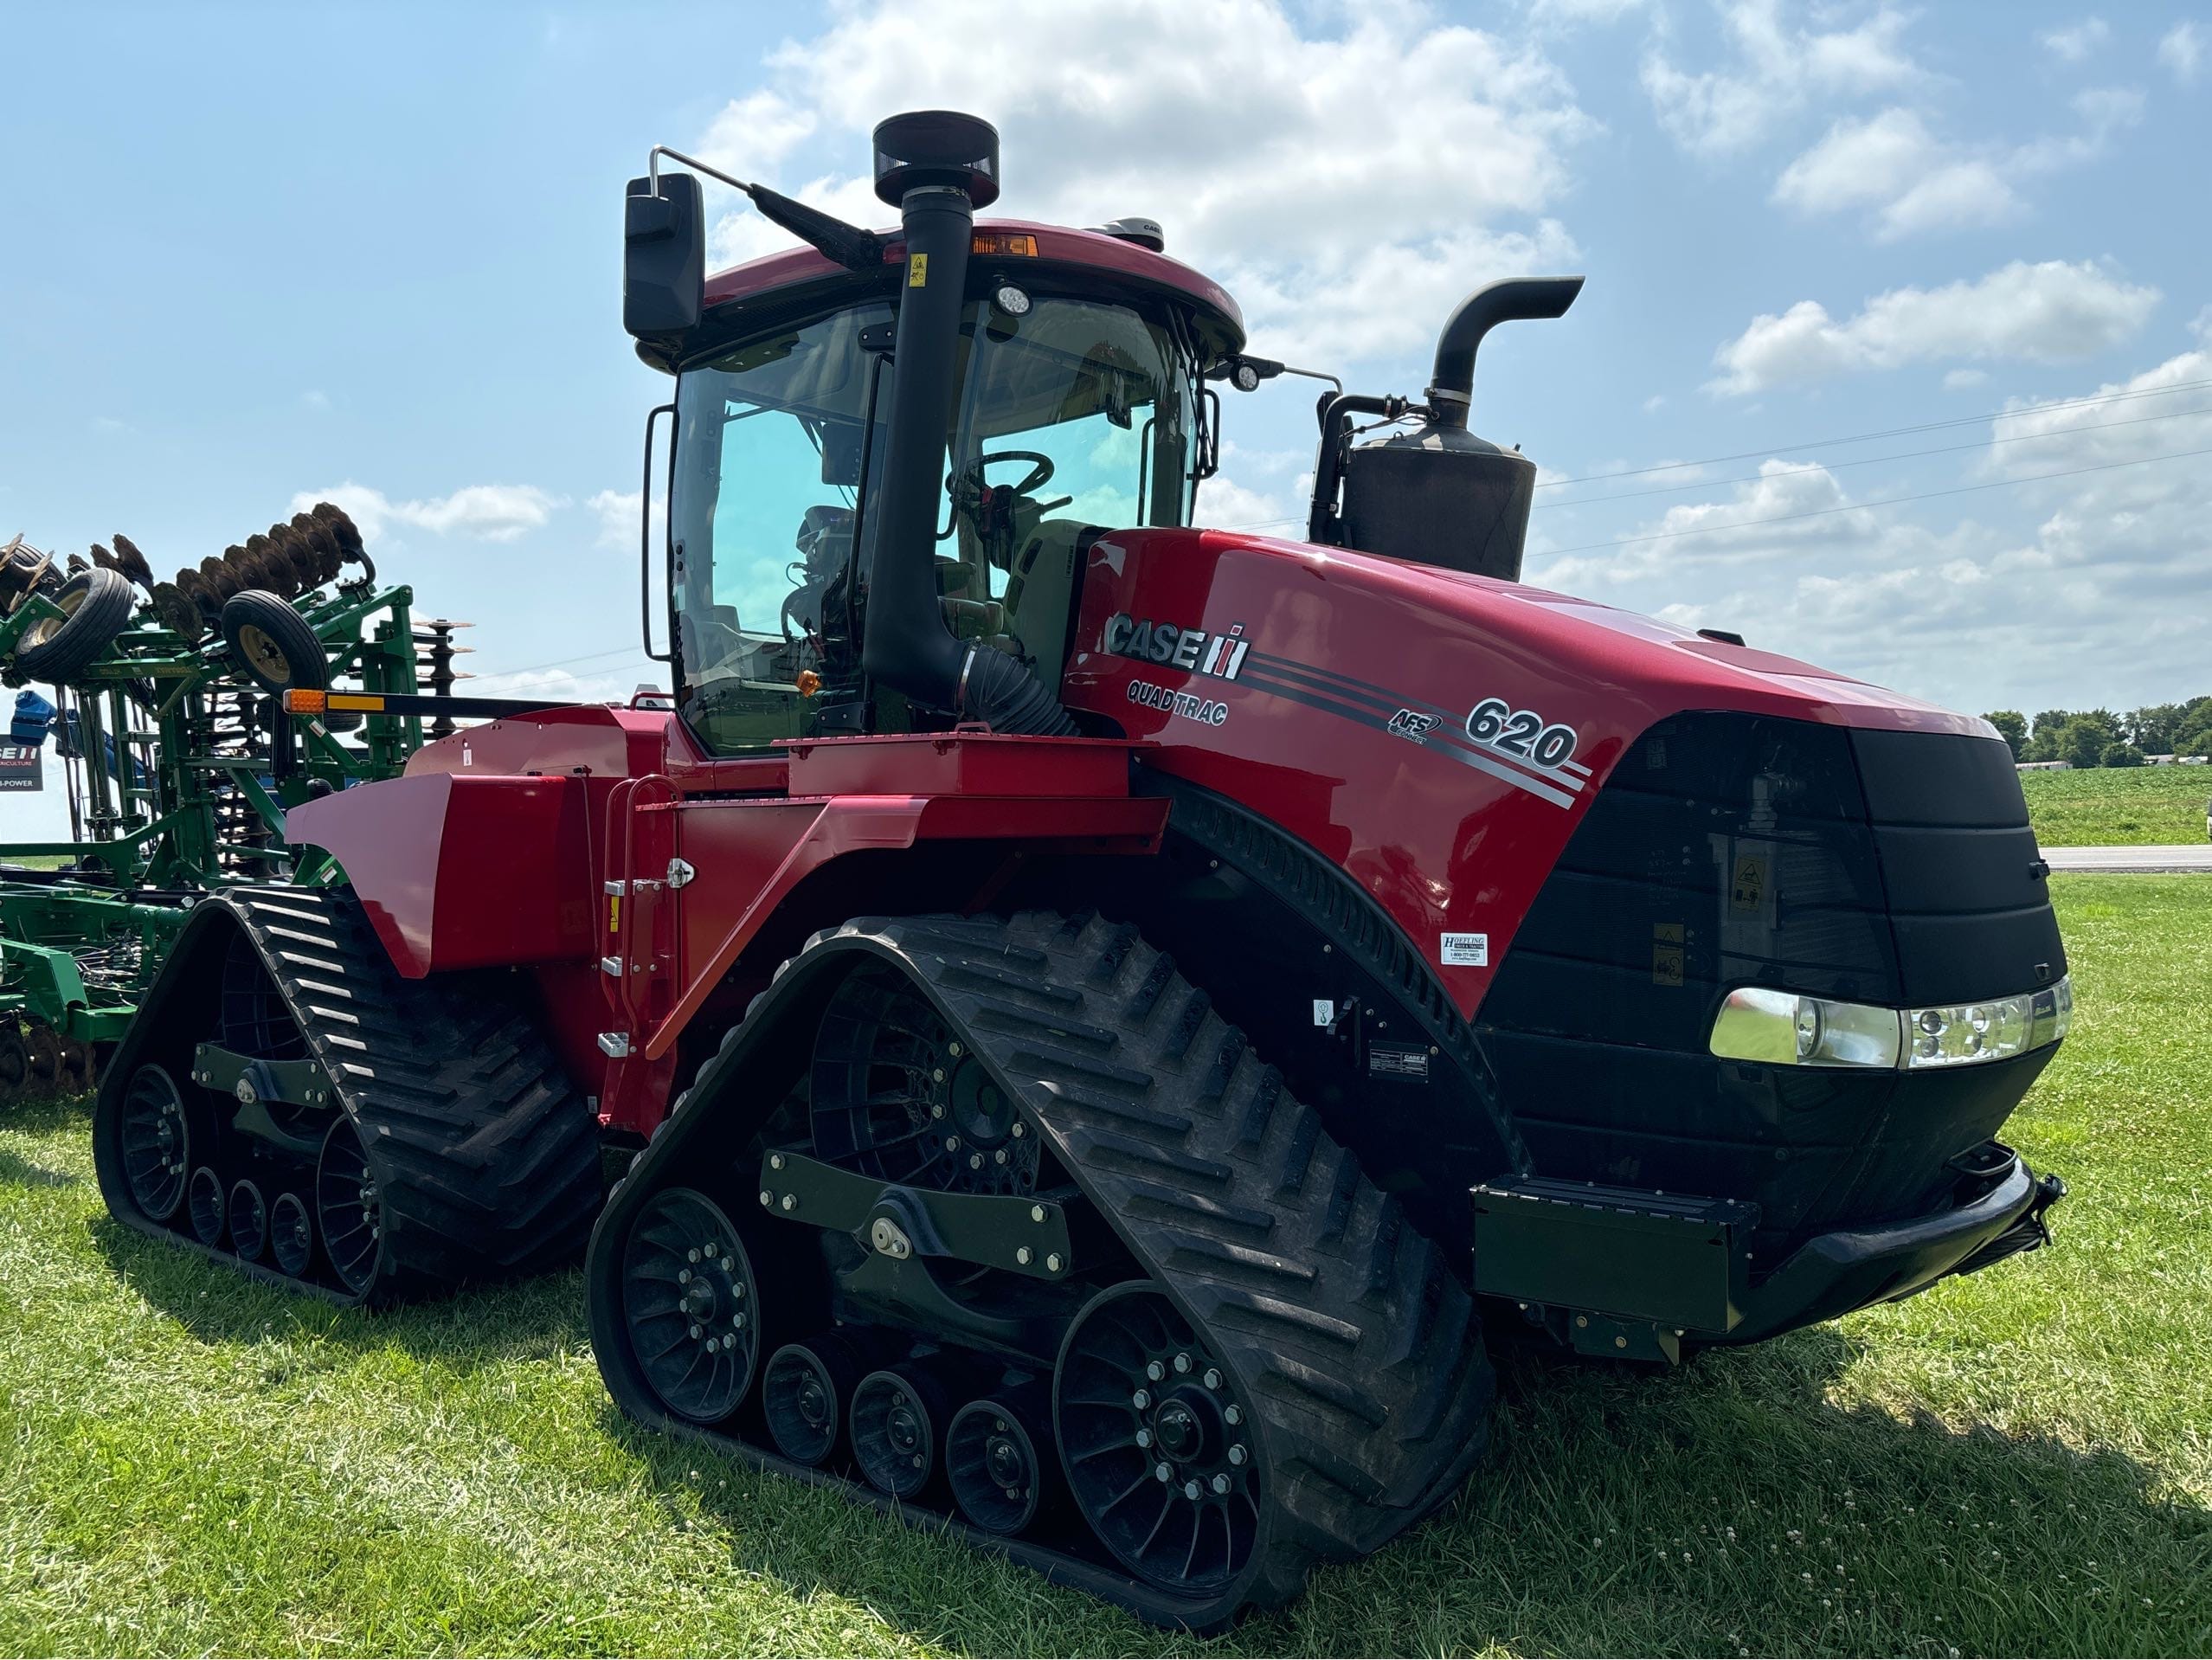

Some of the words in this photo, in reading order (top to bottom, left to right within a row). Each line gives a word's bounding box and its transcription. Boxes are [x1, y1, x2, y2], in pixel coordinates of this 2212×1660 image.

[1107, 613, 1206, 670] CASE
[1127, 679, 1228, 726] QUADTRAC
[1388, 708, 1433, 733] AFS
[1396, 729, 1427, 745] CONNECT
[1465, 698, 1578, 770] 620
[1444, 936, 1484, 948] HOEFLING
